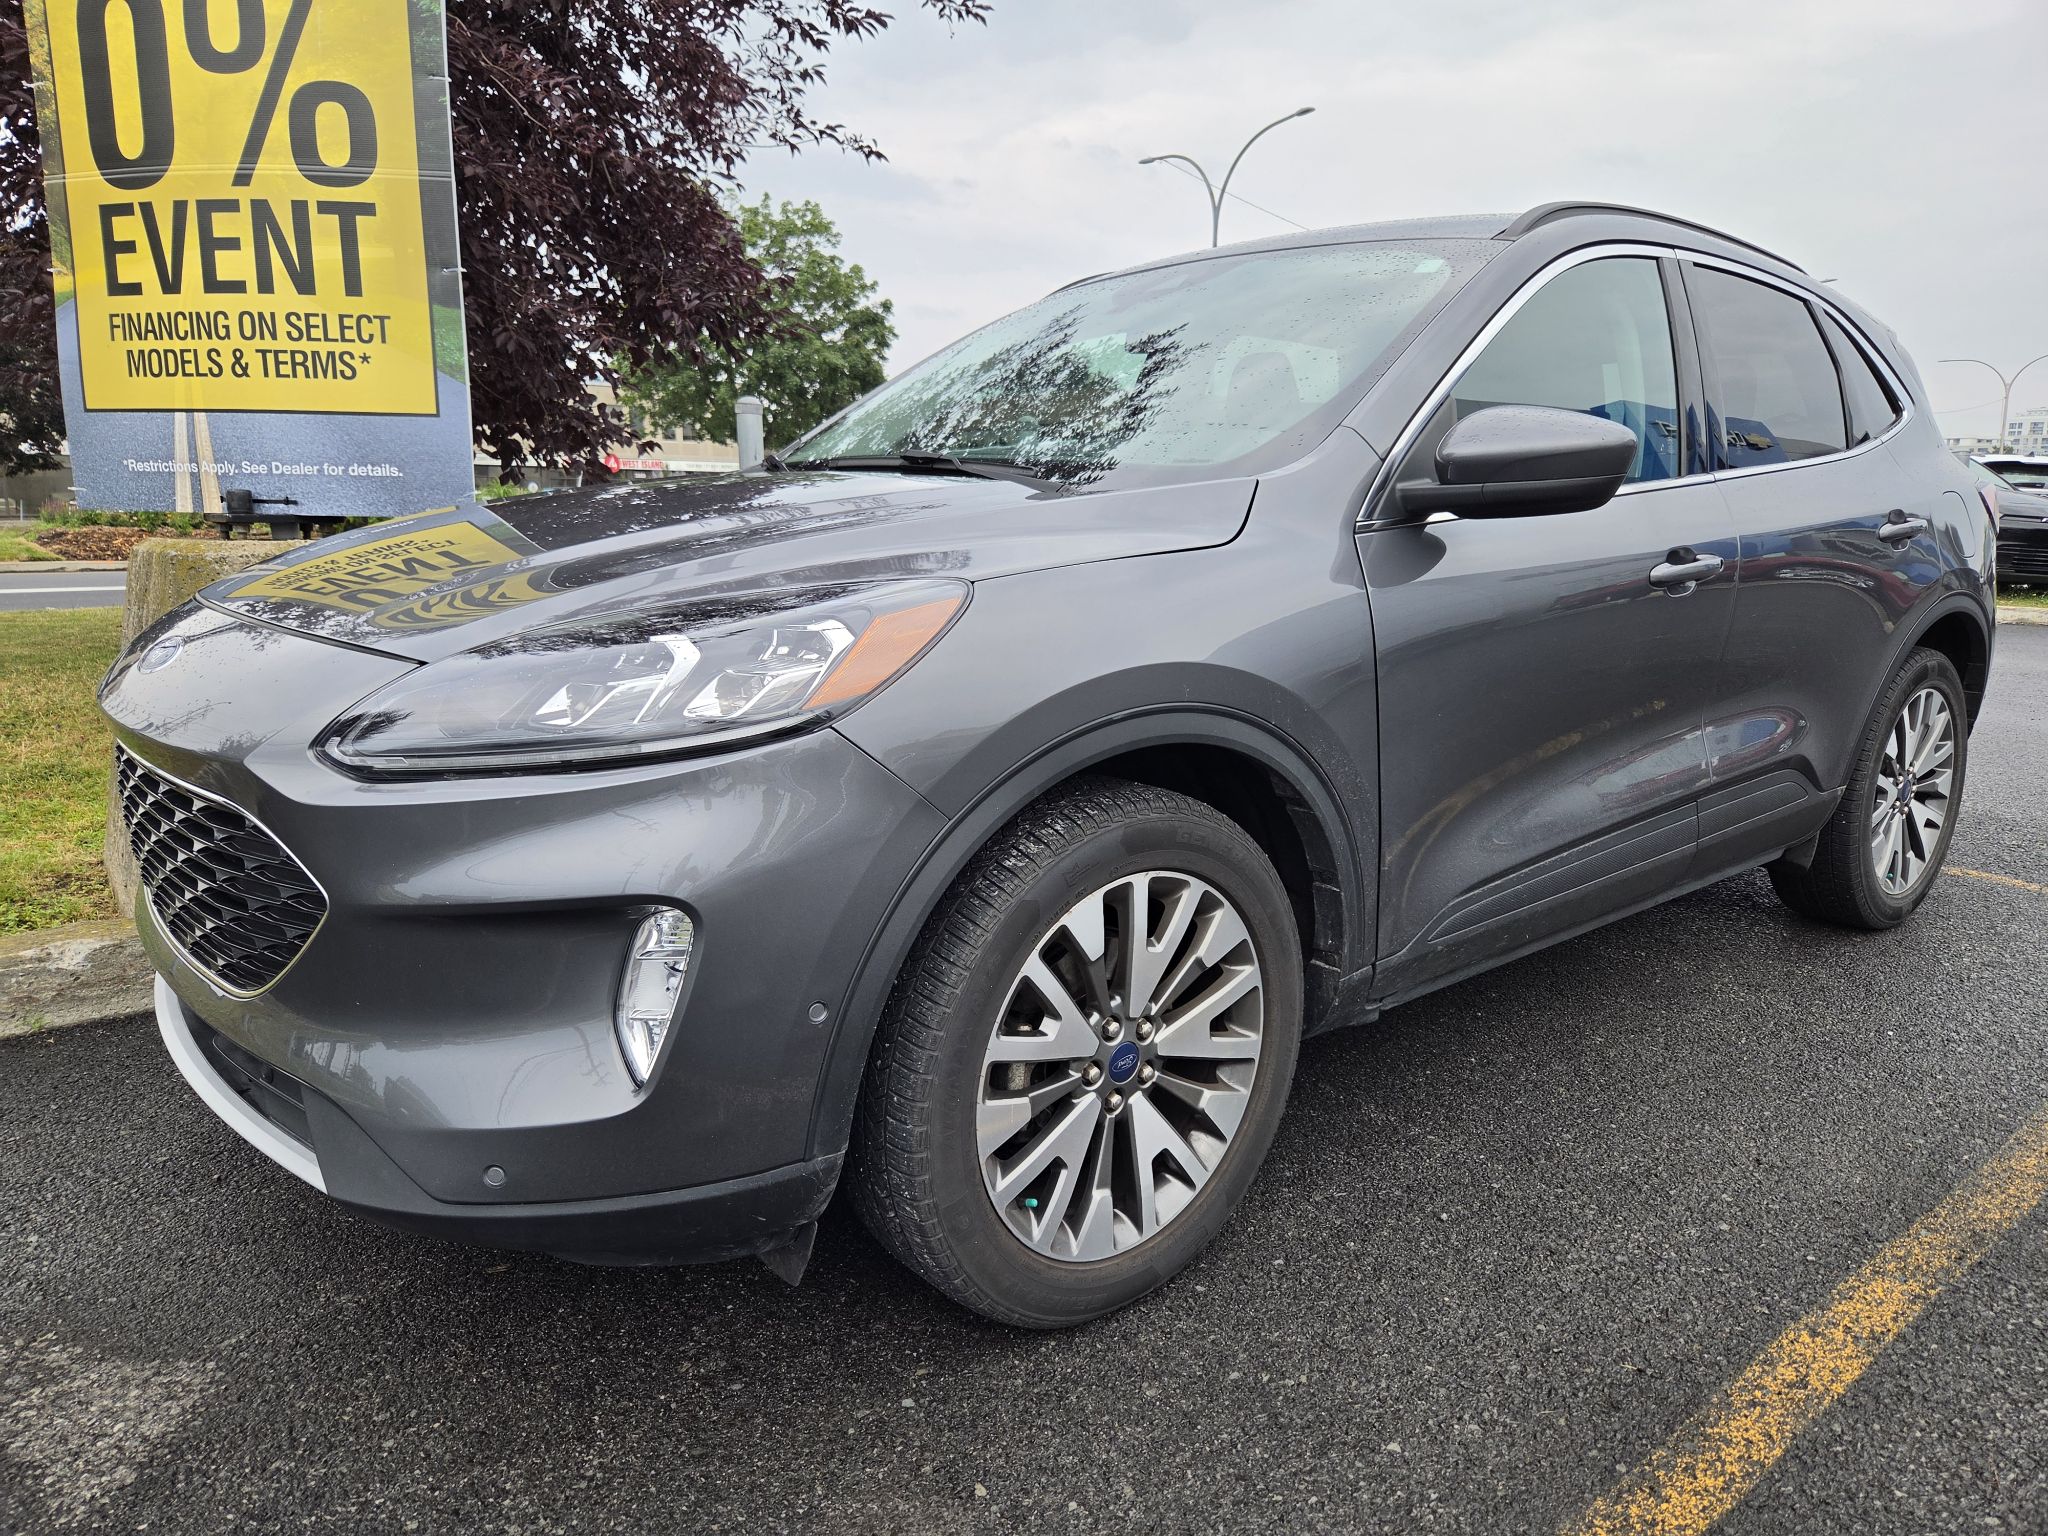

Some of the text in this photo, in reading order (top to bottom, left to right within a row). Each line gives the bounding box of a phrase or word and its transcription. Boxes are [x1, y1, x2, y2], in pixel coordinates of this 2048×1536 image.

[76, 0, 378, 190] 0%
[98, 199, 377, 298] EVENT
[108, 310, 391, 344] FINANCING ON SELECT
[126, 348, 223, 378] MODELS
[230, 348, 250, 378] &
[201, 460, 238, 475] Apply.
[241, 460, 268, 474] See
[271, 461, 319, 475] Dealer
[322, 462, 345, 476] for
[348, 462, 403, 477] details.
[622, 460, 664, 470] WEST ISLAND
